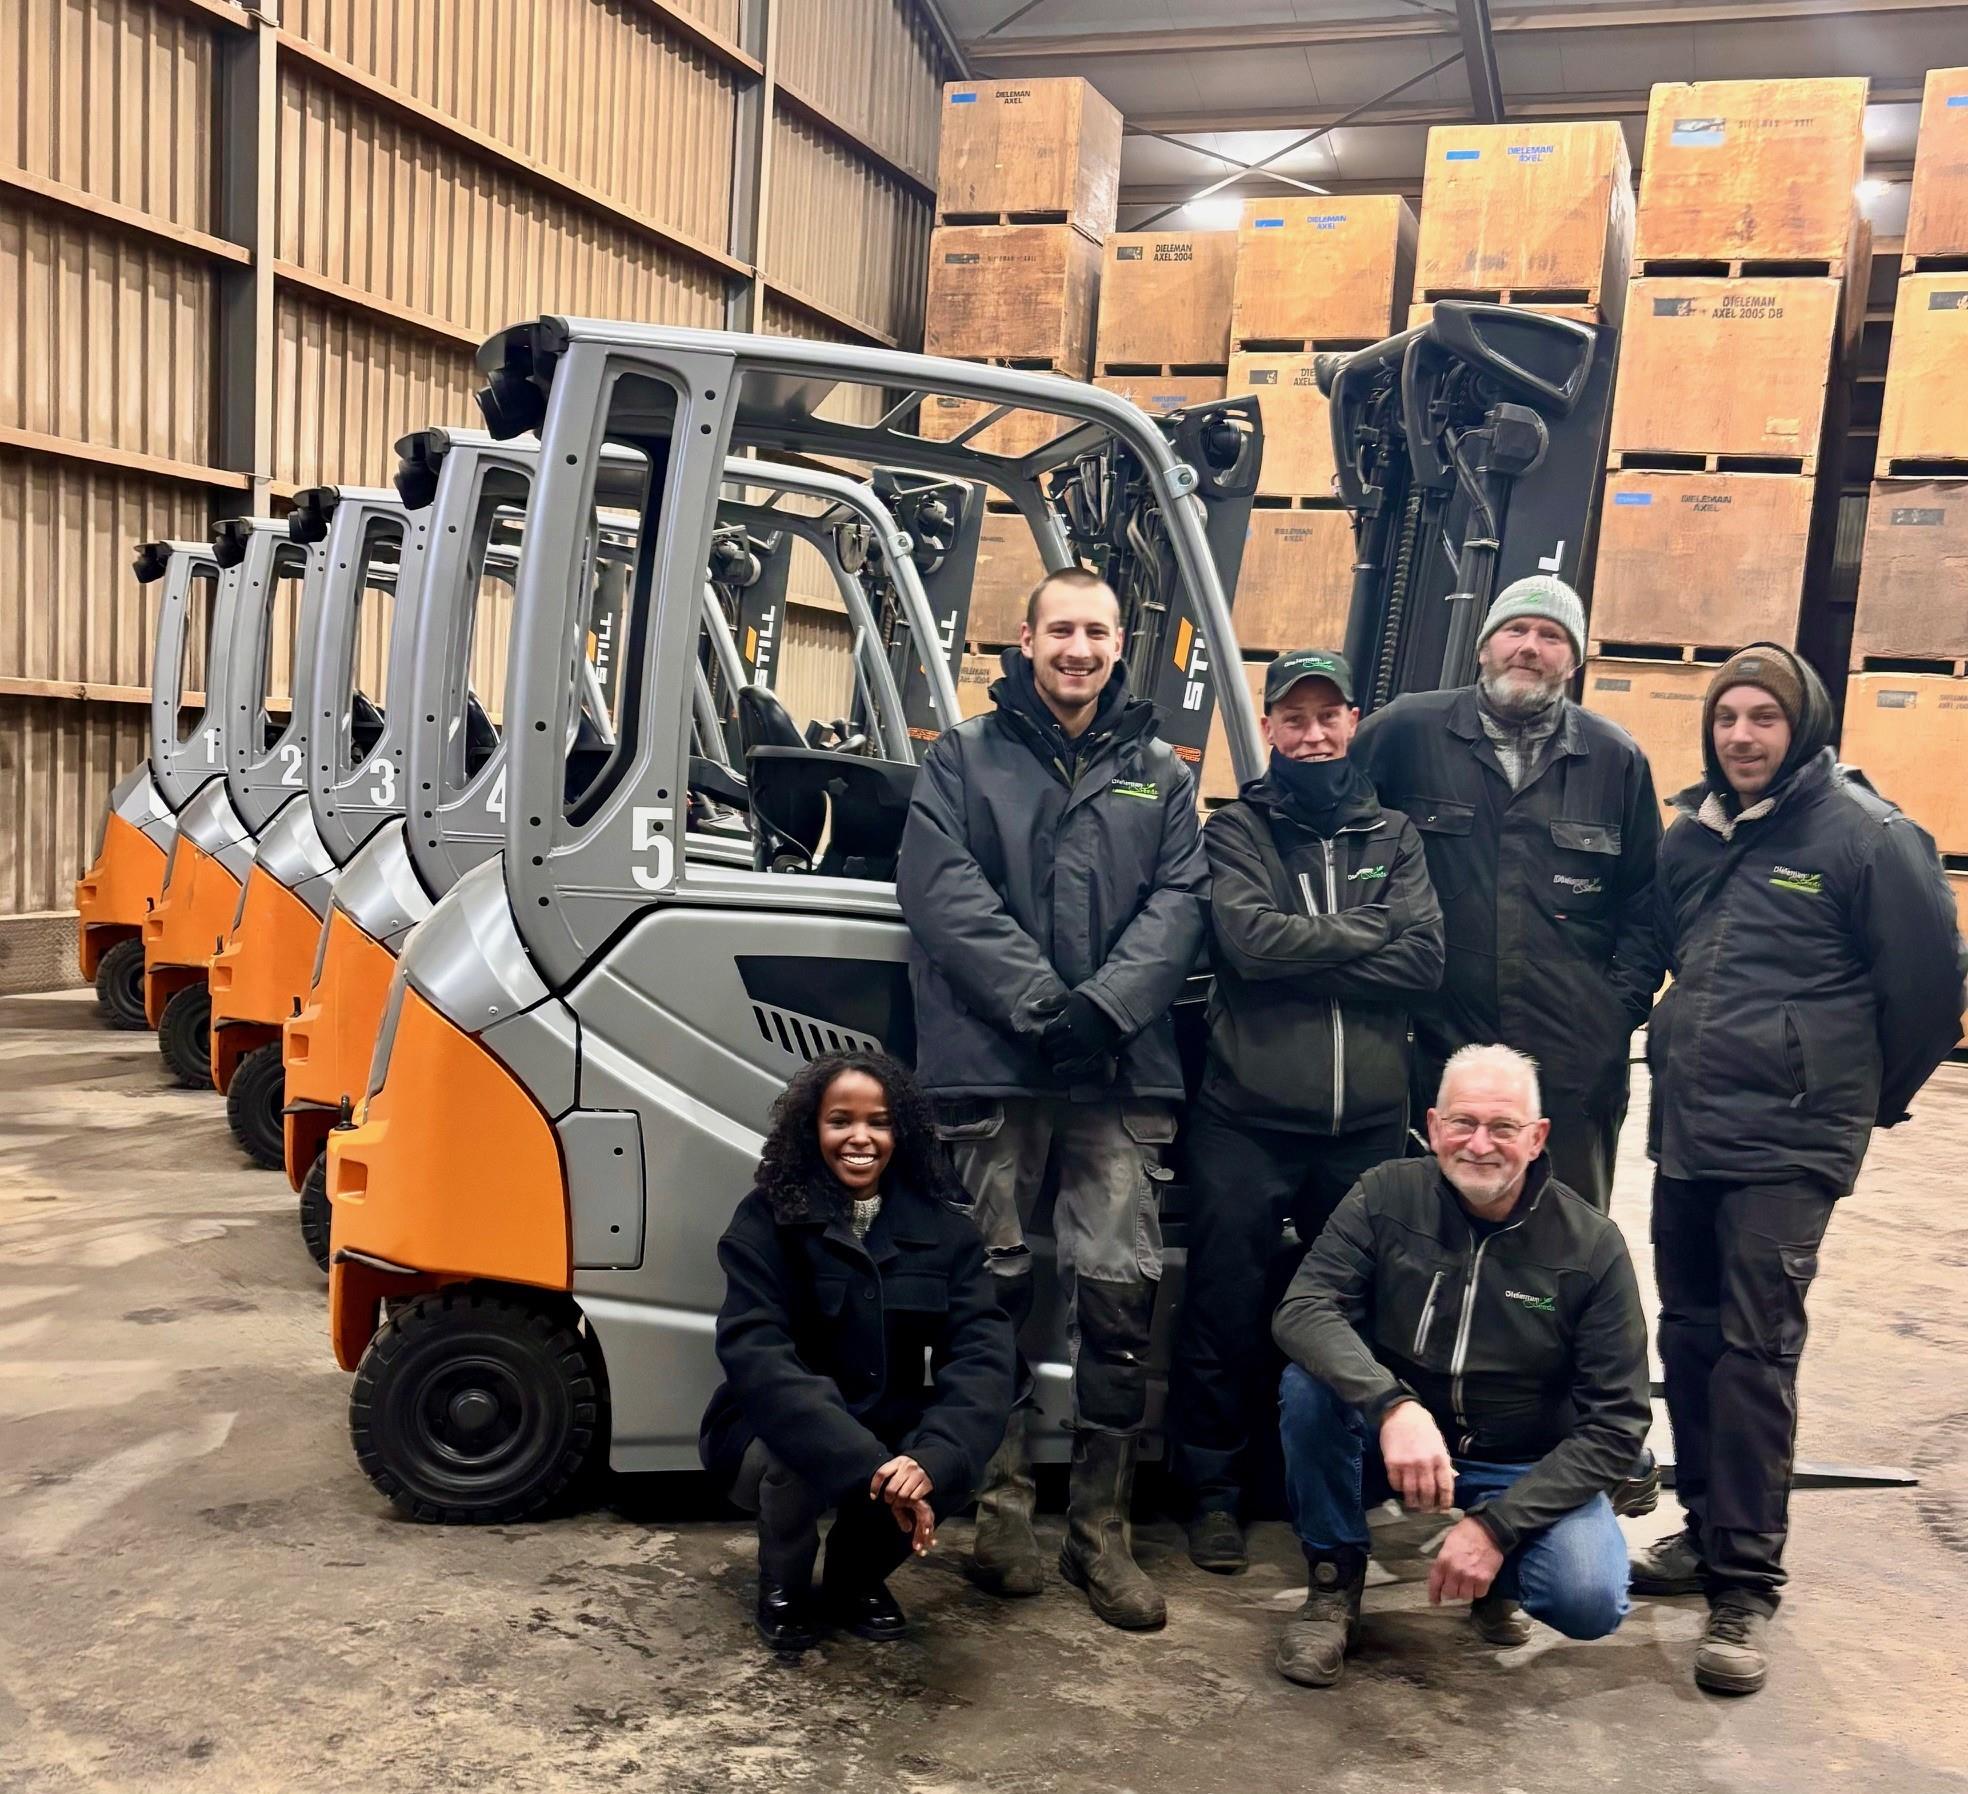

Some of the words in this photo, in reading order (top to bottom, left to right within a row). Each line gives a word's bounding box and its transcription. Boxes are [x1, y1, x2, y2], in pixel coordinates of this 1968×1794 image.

[995, 90, 1031, 98] DIELEMAN
[1153, 253, 1172, 262] AXEL
[1173, 252, 1193, 261] 2004
[1155, 244, 1193, 253] DIELEMAN
[1712, 308, 1737, 319] AXEL
[1740, 308, 1765, 319] 2005
[1768, 308, 1783, 318] DB
[1722, 296, 1776, 307] DIELEMAN
[595, 612, 613, 685] STILL
[754, 605, 776, 688] STILL
[1182, 627, 1209, 711] STI
[203, 728, 215, 764] 1
[280, 744, 303, 785] 2
[369, 758, 396, 806] 3
[485, 763, 507, 823] 4
[631, 806, 674, 890] 5
